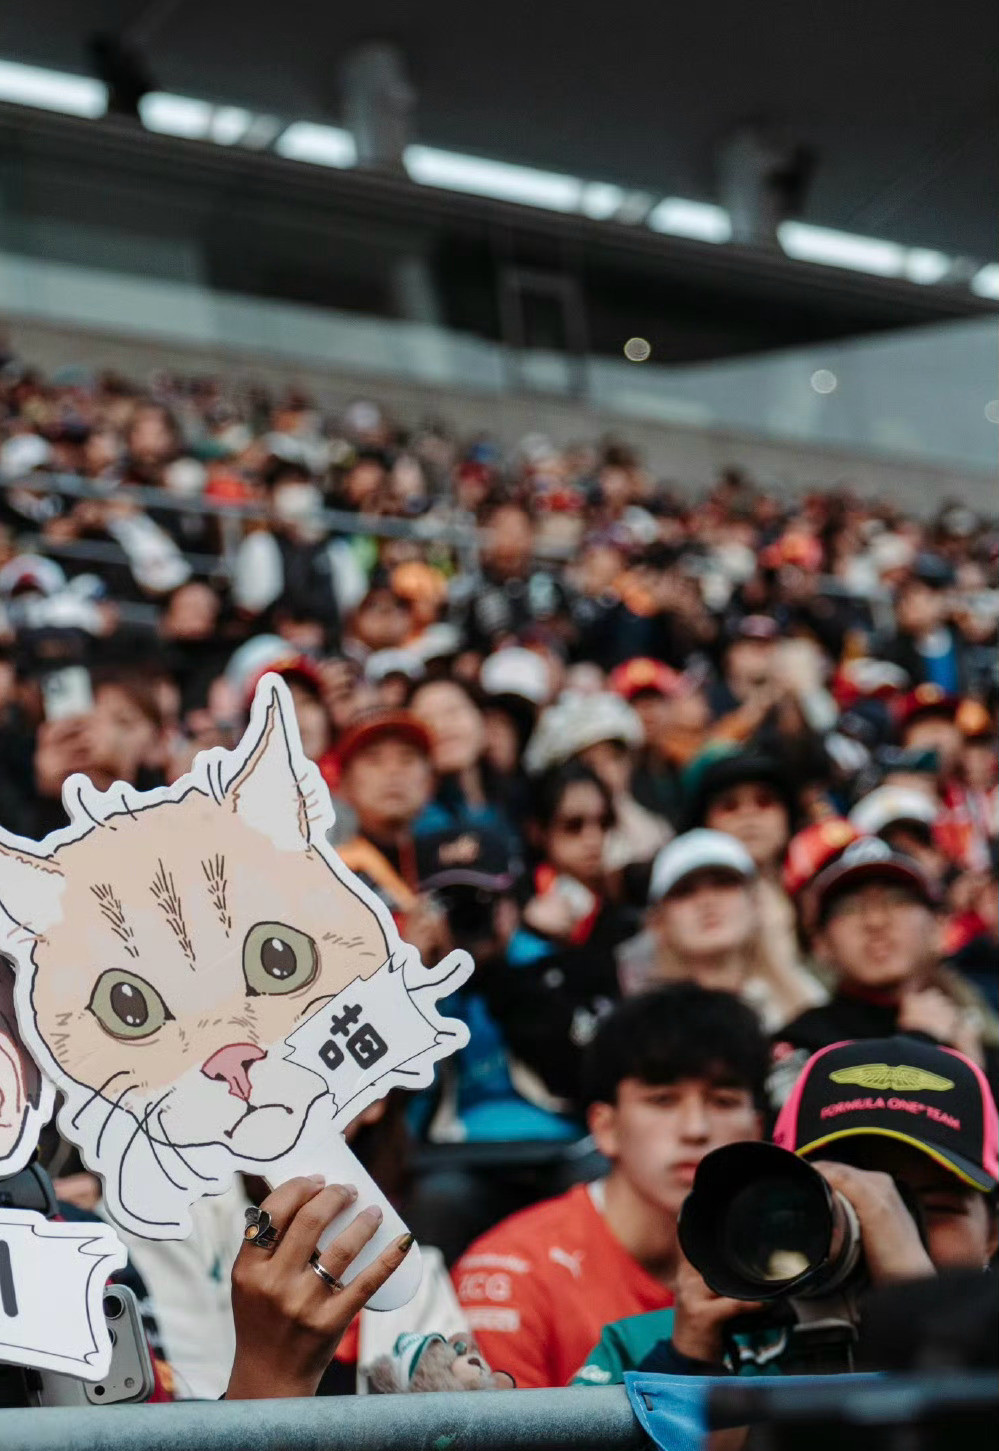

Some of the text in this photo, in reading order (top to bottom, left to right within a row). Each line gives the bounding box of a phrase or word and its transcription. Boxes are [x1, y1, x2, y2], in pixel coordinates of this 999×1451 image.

[318, 1004, 388, 1070] 喵
[820, 1097, 886, 1120] FORMULA
[926, 1106, 961, 1131] TEAM
